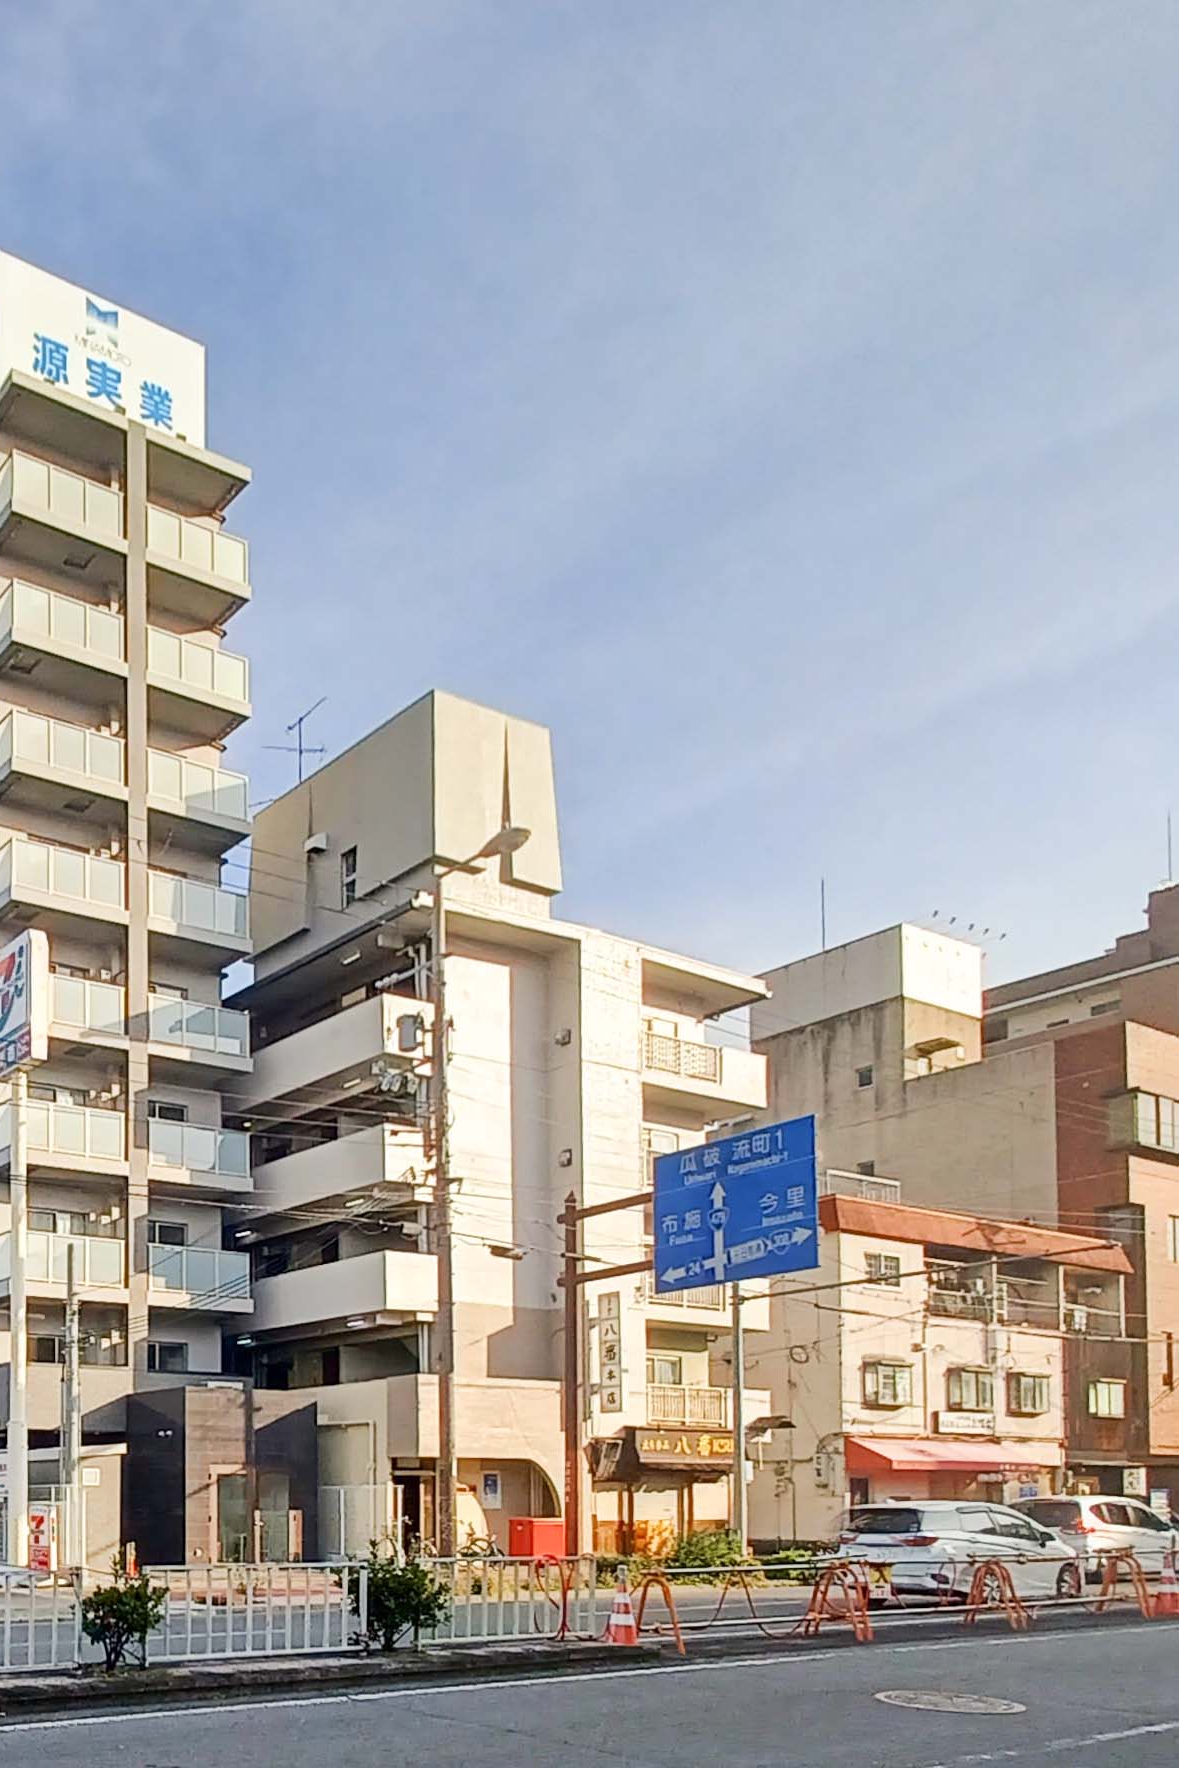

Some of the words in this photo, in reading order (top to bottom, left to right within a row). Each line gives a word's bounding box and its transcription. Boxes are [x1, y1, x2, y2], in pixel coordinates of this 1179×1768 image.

[32, 332, 173, 430] 源実業
[680, 1147, 721, 1174] 瓜破
[759, 1186, 805, 1214] 今里
[687, 1261, 702, 1276] 24
